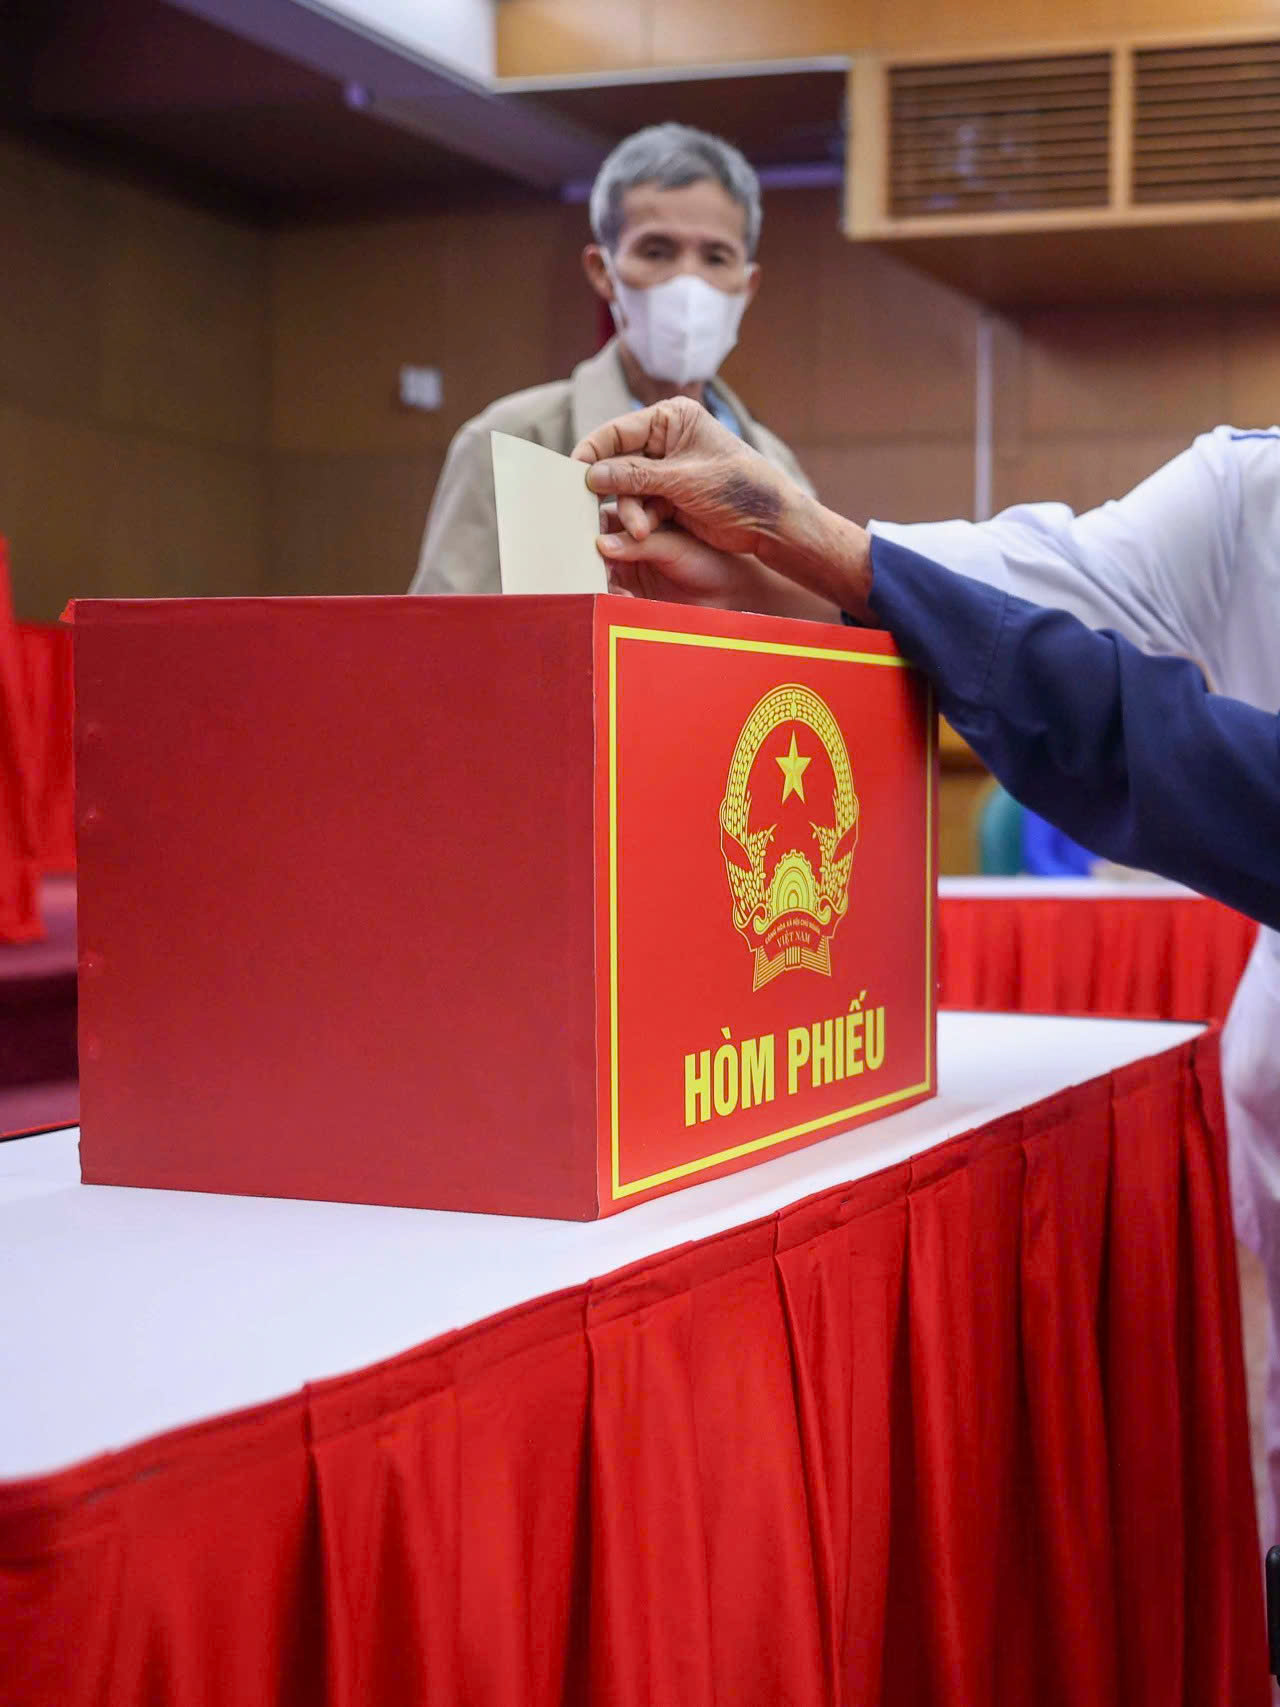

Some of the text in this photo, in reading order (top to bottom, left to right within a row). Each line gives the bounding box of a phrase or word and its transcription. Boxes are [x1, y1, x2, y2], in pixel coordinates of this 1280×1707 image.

[776, 929, 810, 948] VIỆT NAM
[684, 989, 886, 1128] HÒM PHIẾU
